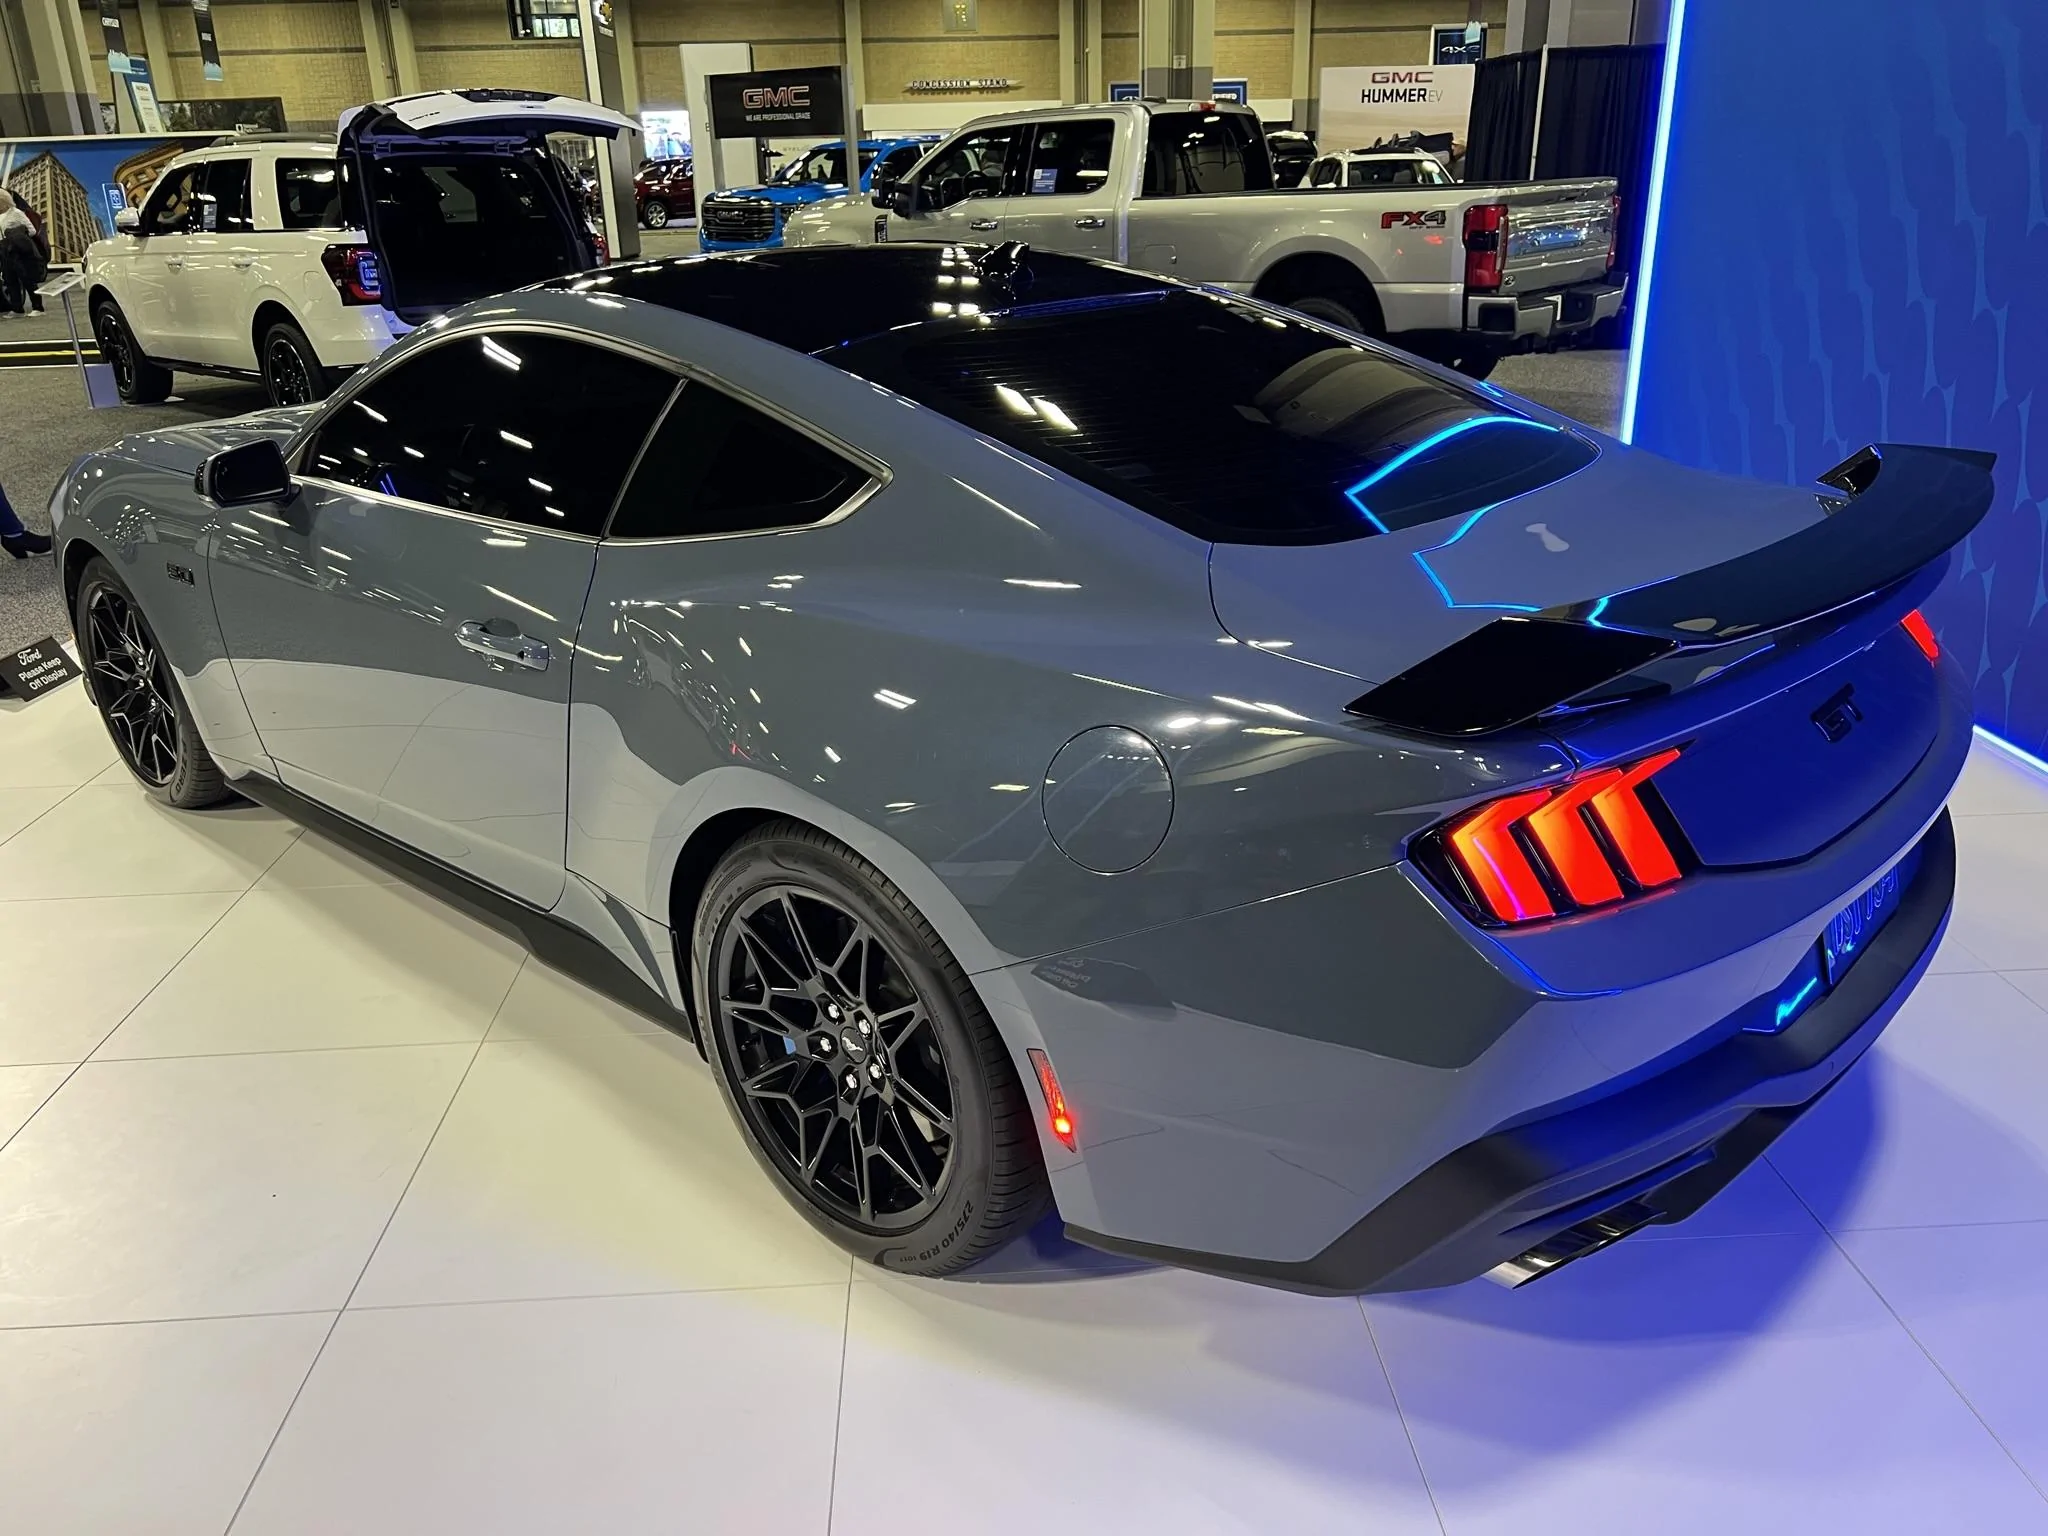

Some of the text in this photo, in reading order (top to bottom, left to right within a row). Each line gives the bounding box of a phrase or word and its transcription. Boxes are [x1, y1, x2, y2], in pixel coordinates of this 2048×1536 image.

[912, 78, 1008, 89] CONCESSION STAND
[1371, 71, 1434, 84] GMC
[743, 85, 811, 109] GMC
[1361, 87, 1443, 104] HUMMER EV
[762, 112, 795, 121] PROFESSIONAL
[795, 111, 811, 120] GRADE
[1380, 210, 1447, 229] FX4
[17, 648, 43, 666] Ford
[18, 656, 62, 682] Please Keep
[29, 667, 68, 690] Off Display
[1810, 683, 1862, 744] GT
[940, 1199, 975, 1249] 275/40
[919, 1244, 941, 1261] R19
